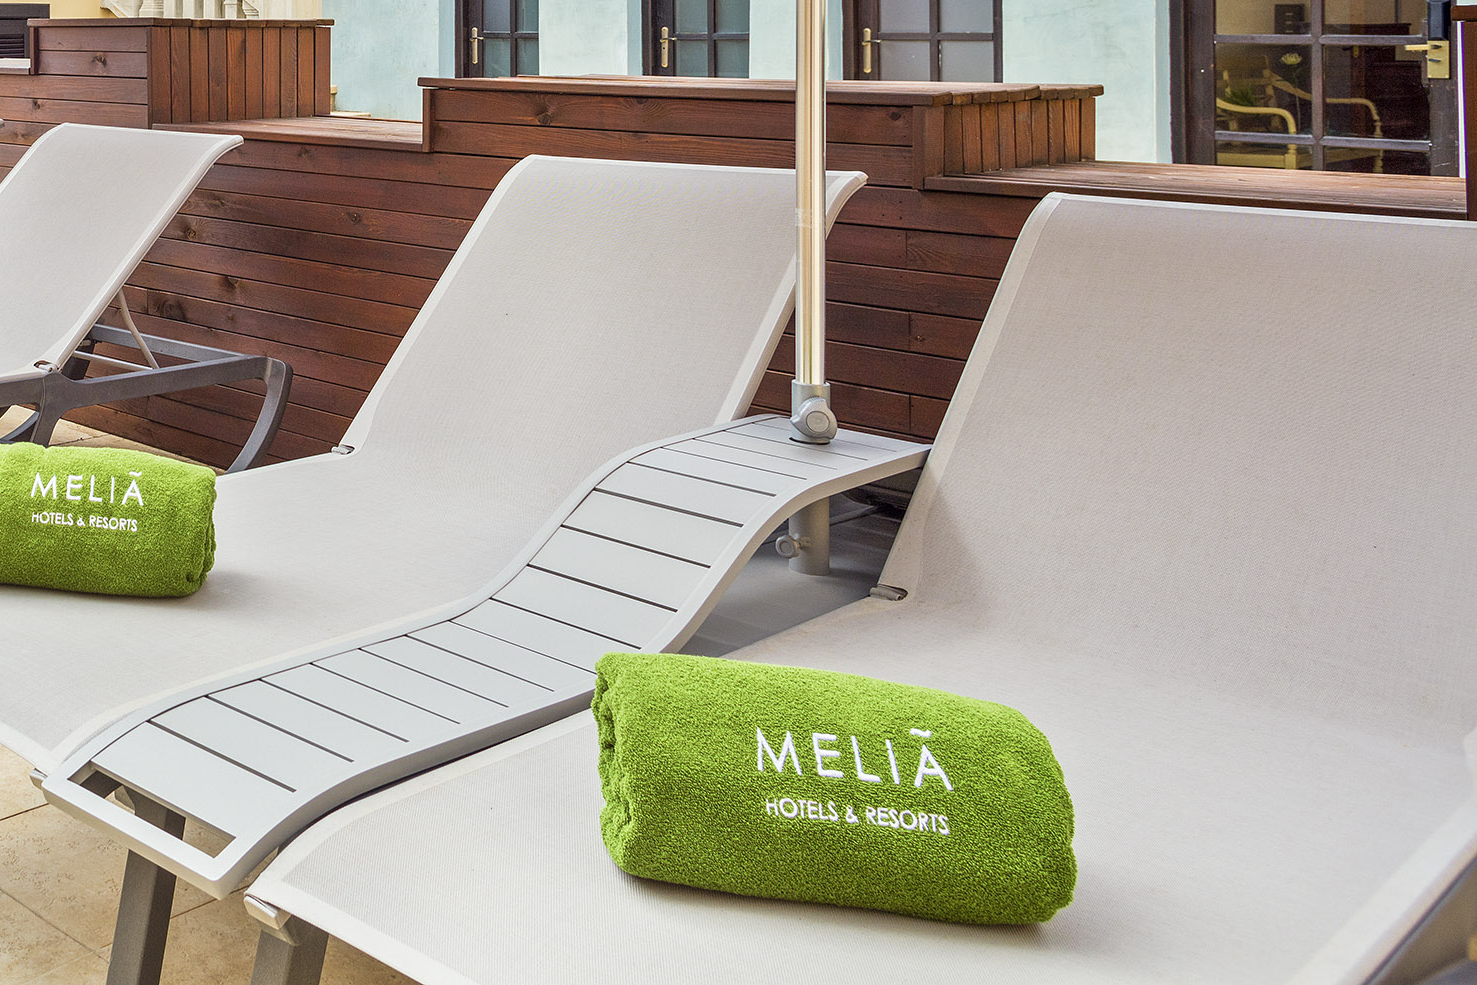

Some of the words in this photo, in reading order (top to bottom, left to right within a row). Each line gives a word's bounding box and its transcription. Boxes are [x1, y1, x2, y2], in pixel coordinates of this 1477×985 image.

[31, 511, 74, 526] HOTELS
[76, 517, 86, 527] &
[88, 515, 138, 532] RESORTS
[765, 797, 839, 822] HOTELS
[845, 805, 860, 824] &
[865, 806, 950, 836] RESORTS
